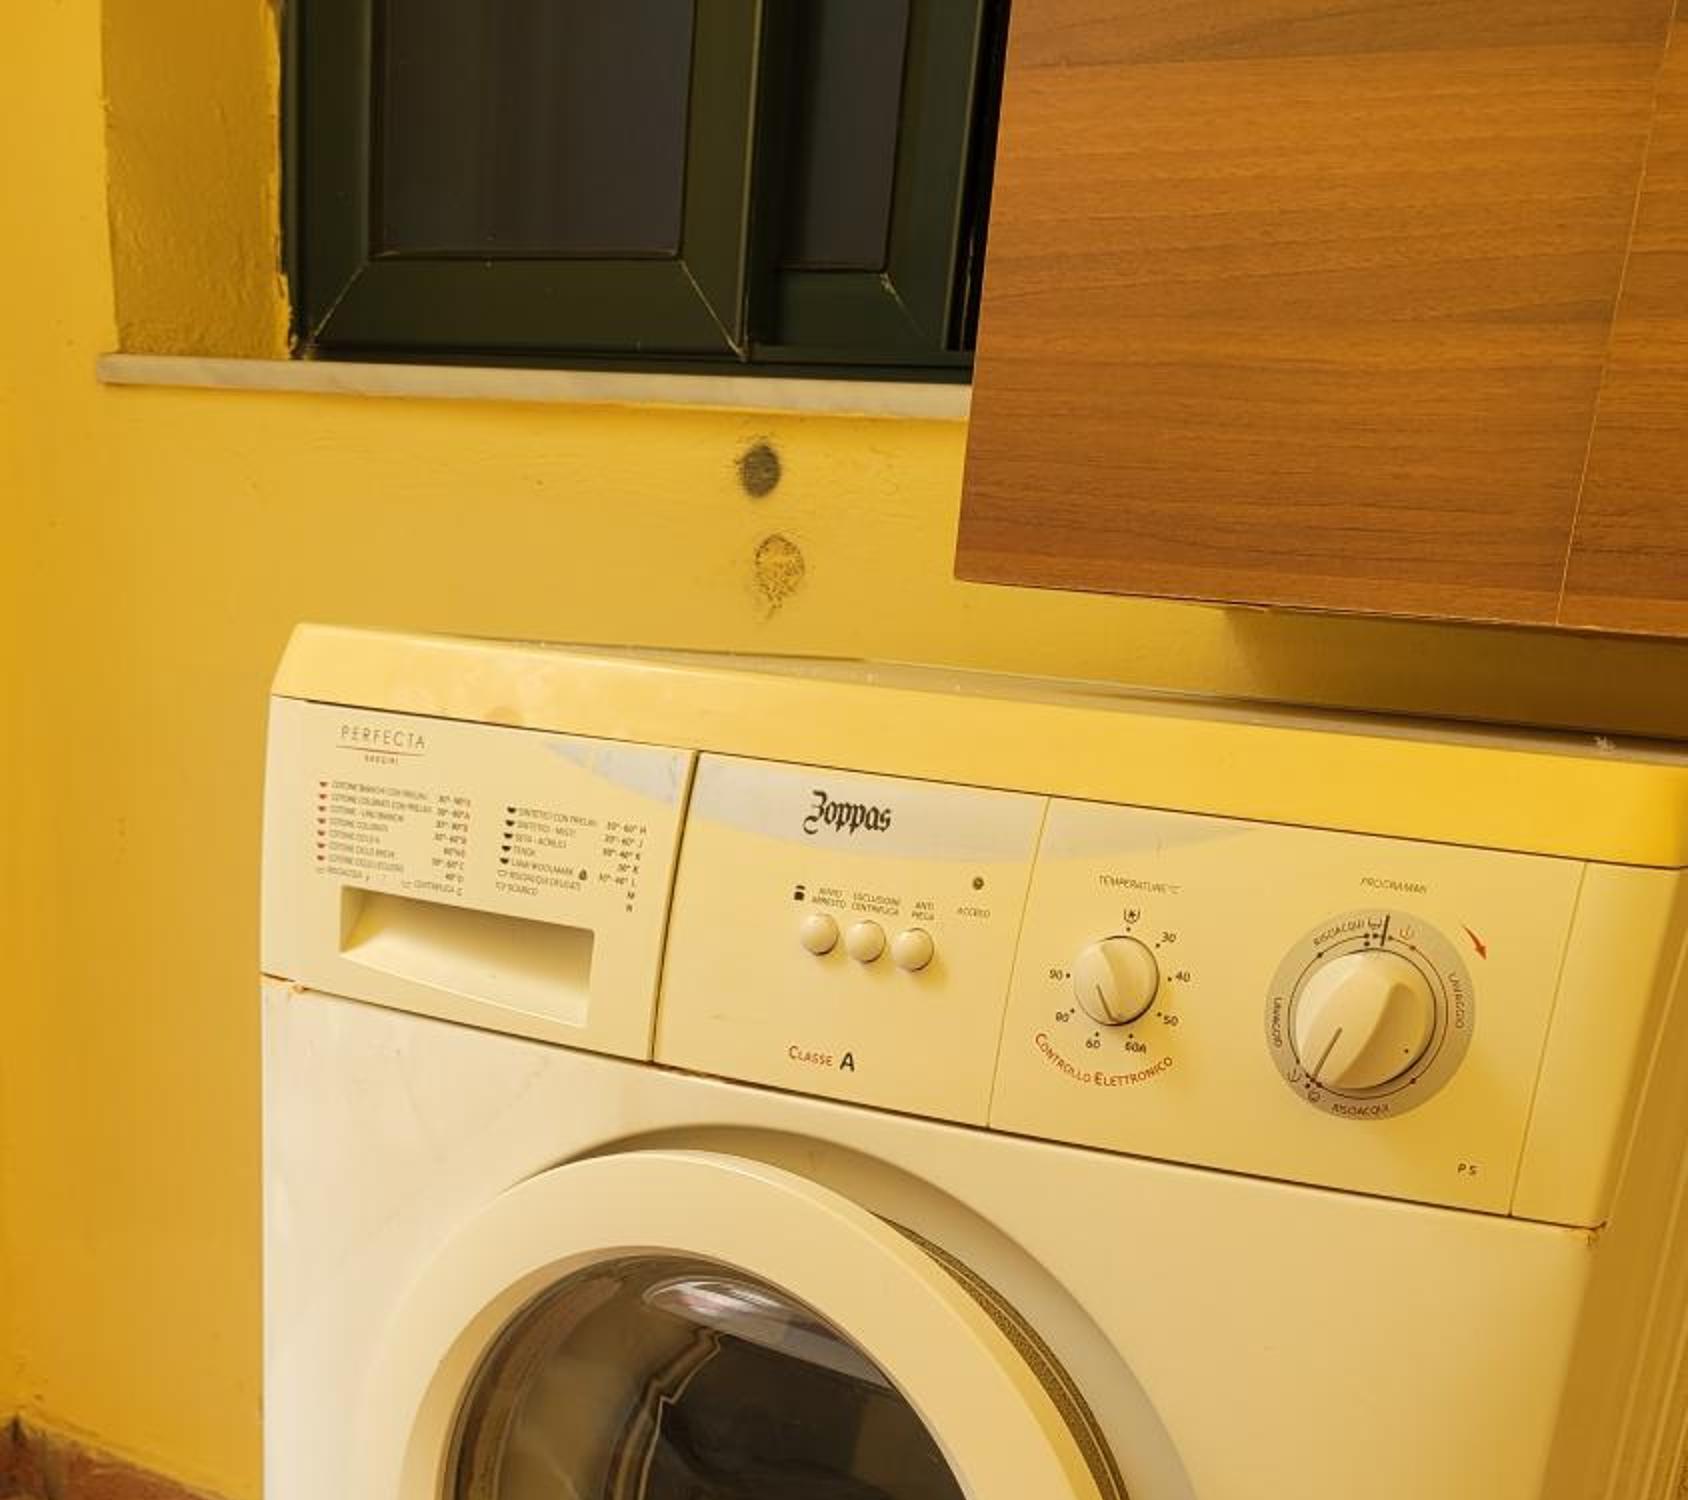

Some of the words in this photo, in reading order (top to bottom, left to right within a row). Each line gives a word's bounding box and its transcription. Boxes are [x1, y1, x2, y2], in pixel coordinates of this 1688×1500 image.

[341, 725, 425, 748] PERFECTA
[803, 790, 891, 835] Zoppas
[851, 902, 900, 917] CENTRIFUGA
[915, 901, 935, 912] ANTI
[1161, 931, 1177, 943] 30
[1050, 969, 1063, 981] 90
[1175, 970, 1191, 983] 40
[1055, 1011, 1070, 1023] 80
[1163, 1015, 1179, 1027] 50
[1086, 1038, 1101, 1050] 60
[839, 1051, 855, 1072] A
[1095, 1056, 1174, 1087] ELETTRONICO
